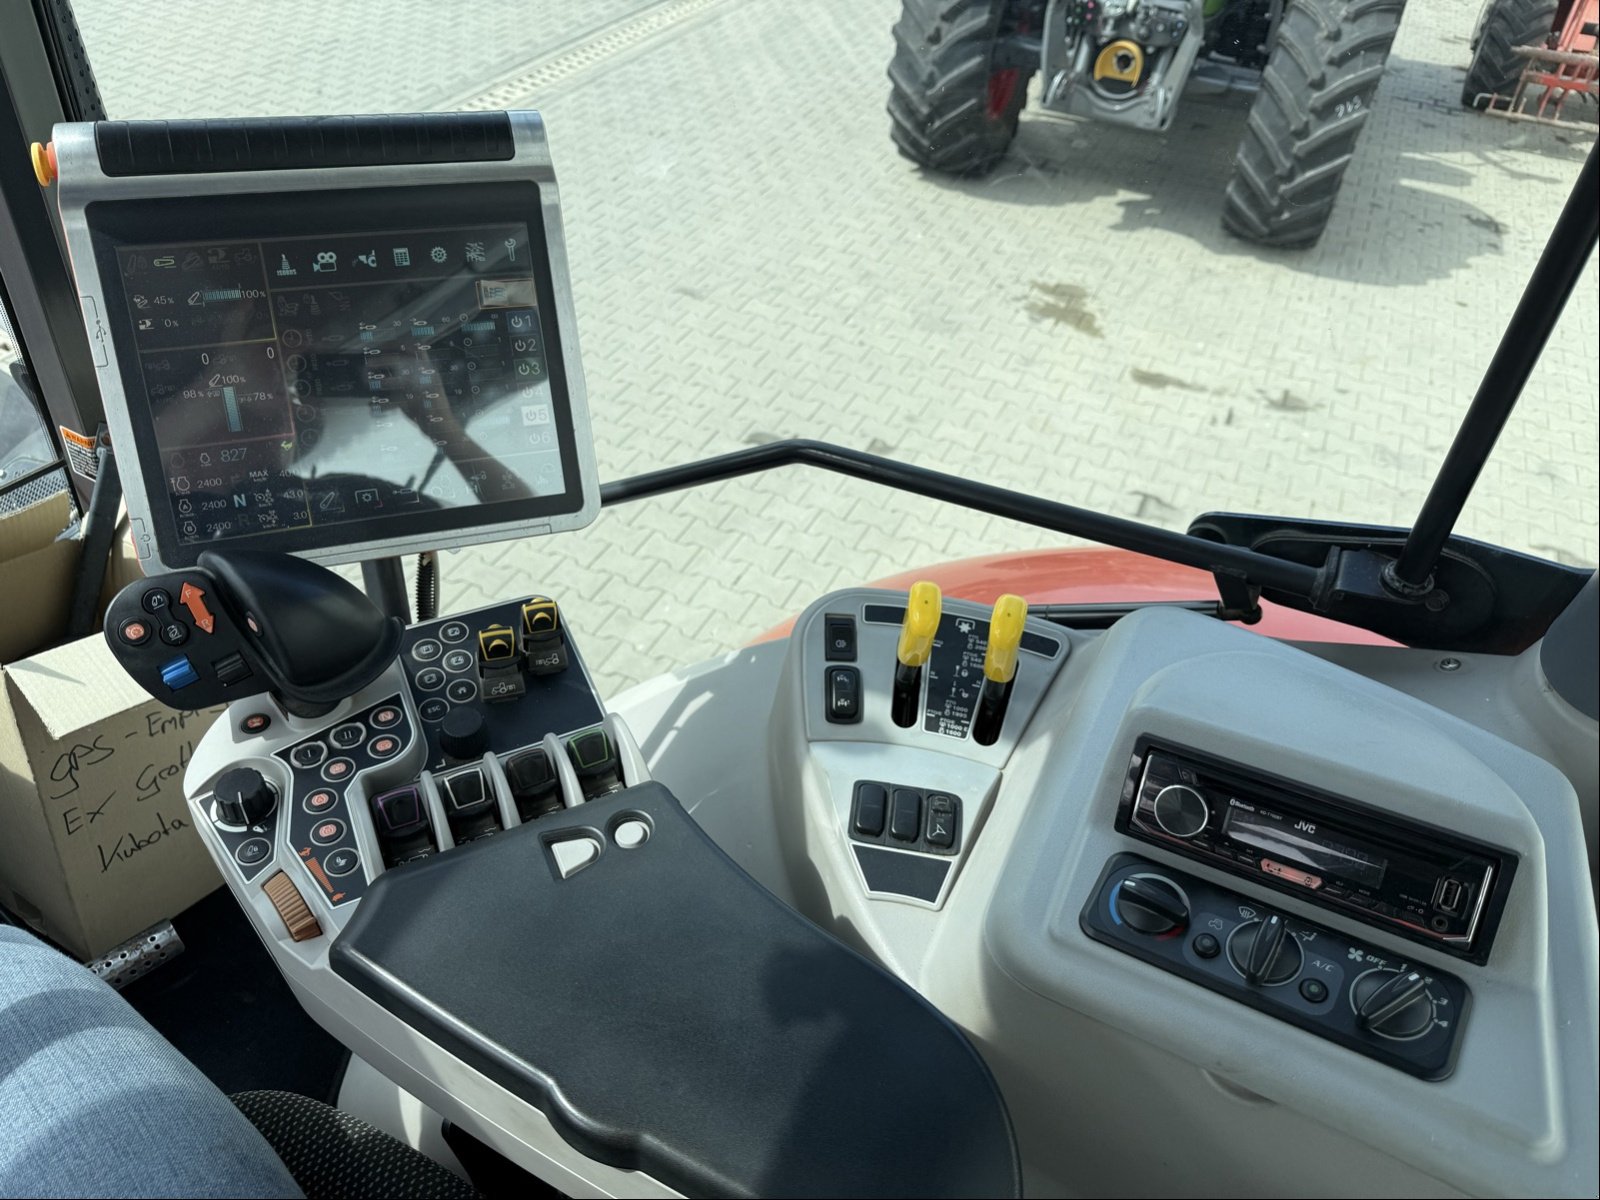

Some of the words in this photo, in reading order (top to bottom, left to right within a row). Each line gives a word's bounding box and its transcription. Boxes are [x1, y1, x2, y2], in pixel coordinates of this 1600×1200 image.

[241, 289, 266, 299] 100%
[202, 353, 210, 365] 0
[221, 374, 246, 384] 100%
[221, 448, 247, 463] 827
[249, 469, 269, 478] MAX
[197, 478, 222, 489] 2400
[202, 500, 227, 511] 2400
[233, 493, 247, 508] N
[293, 511, 308, 520] 3.0
[206, 520, 232, 532] 2400
[427, 705, 441, 714] ESC
[1294, 820, 1316, 834] JVC
[97, 812, 191, 874] Kubota
[1366, 954, 1388, 965] OFF
[1311, 959, 1336, 972] A/C
